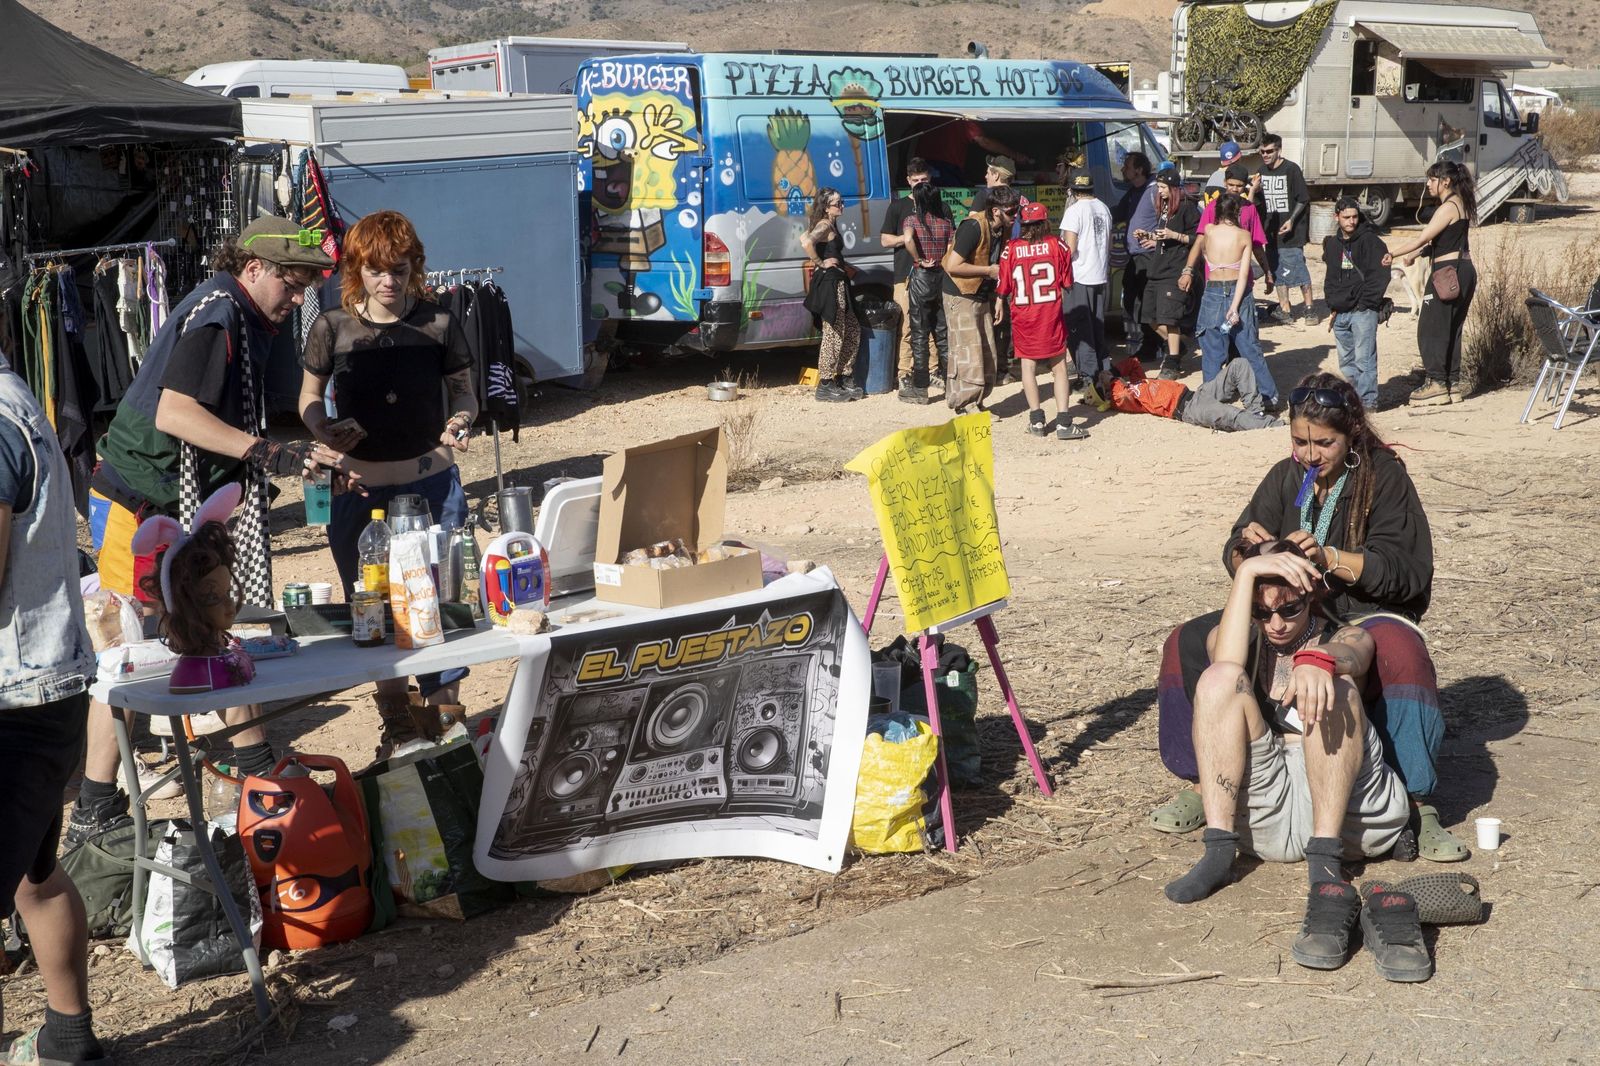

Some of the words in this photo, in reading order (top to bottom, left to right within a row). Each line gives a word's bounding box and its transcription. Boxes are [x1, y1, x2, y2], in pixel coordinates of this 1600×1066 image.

[724, 61, 830, 96] PIZZA
[884, 64, 990, 96] BURGER
[1015, 242, 1049, 259] DILFER
[1012, 260, 1058, 306] 12
[881, 467, 953, 507] CERVEZA
[897, 525, 960, 560] SANDWICH
[901, 566, 945, 594] OFERTAS
[577, 651, 627, 684] EL
[630, 611, 812, 676] PUESTAZO
